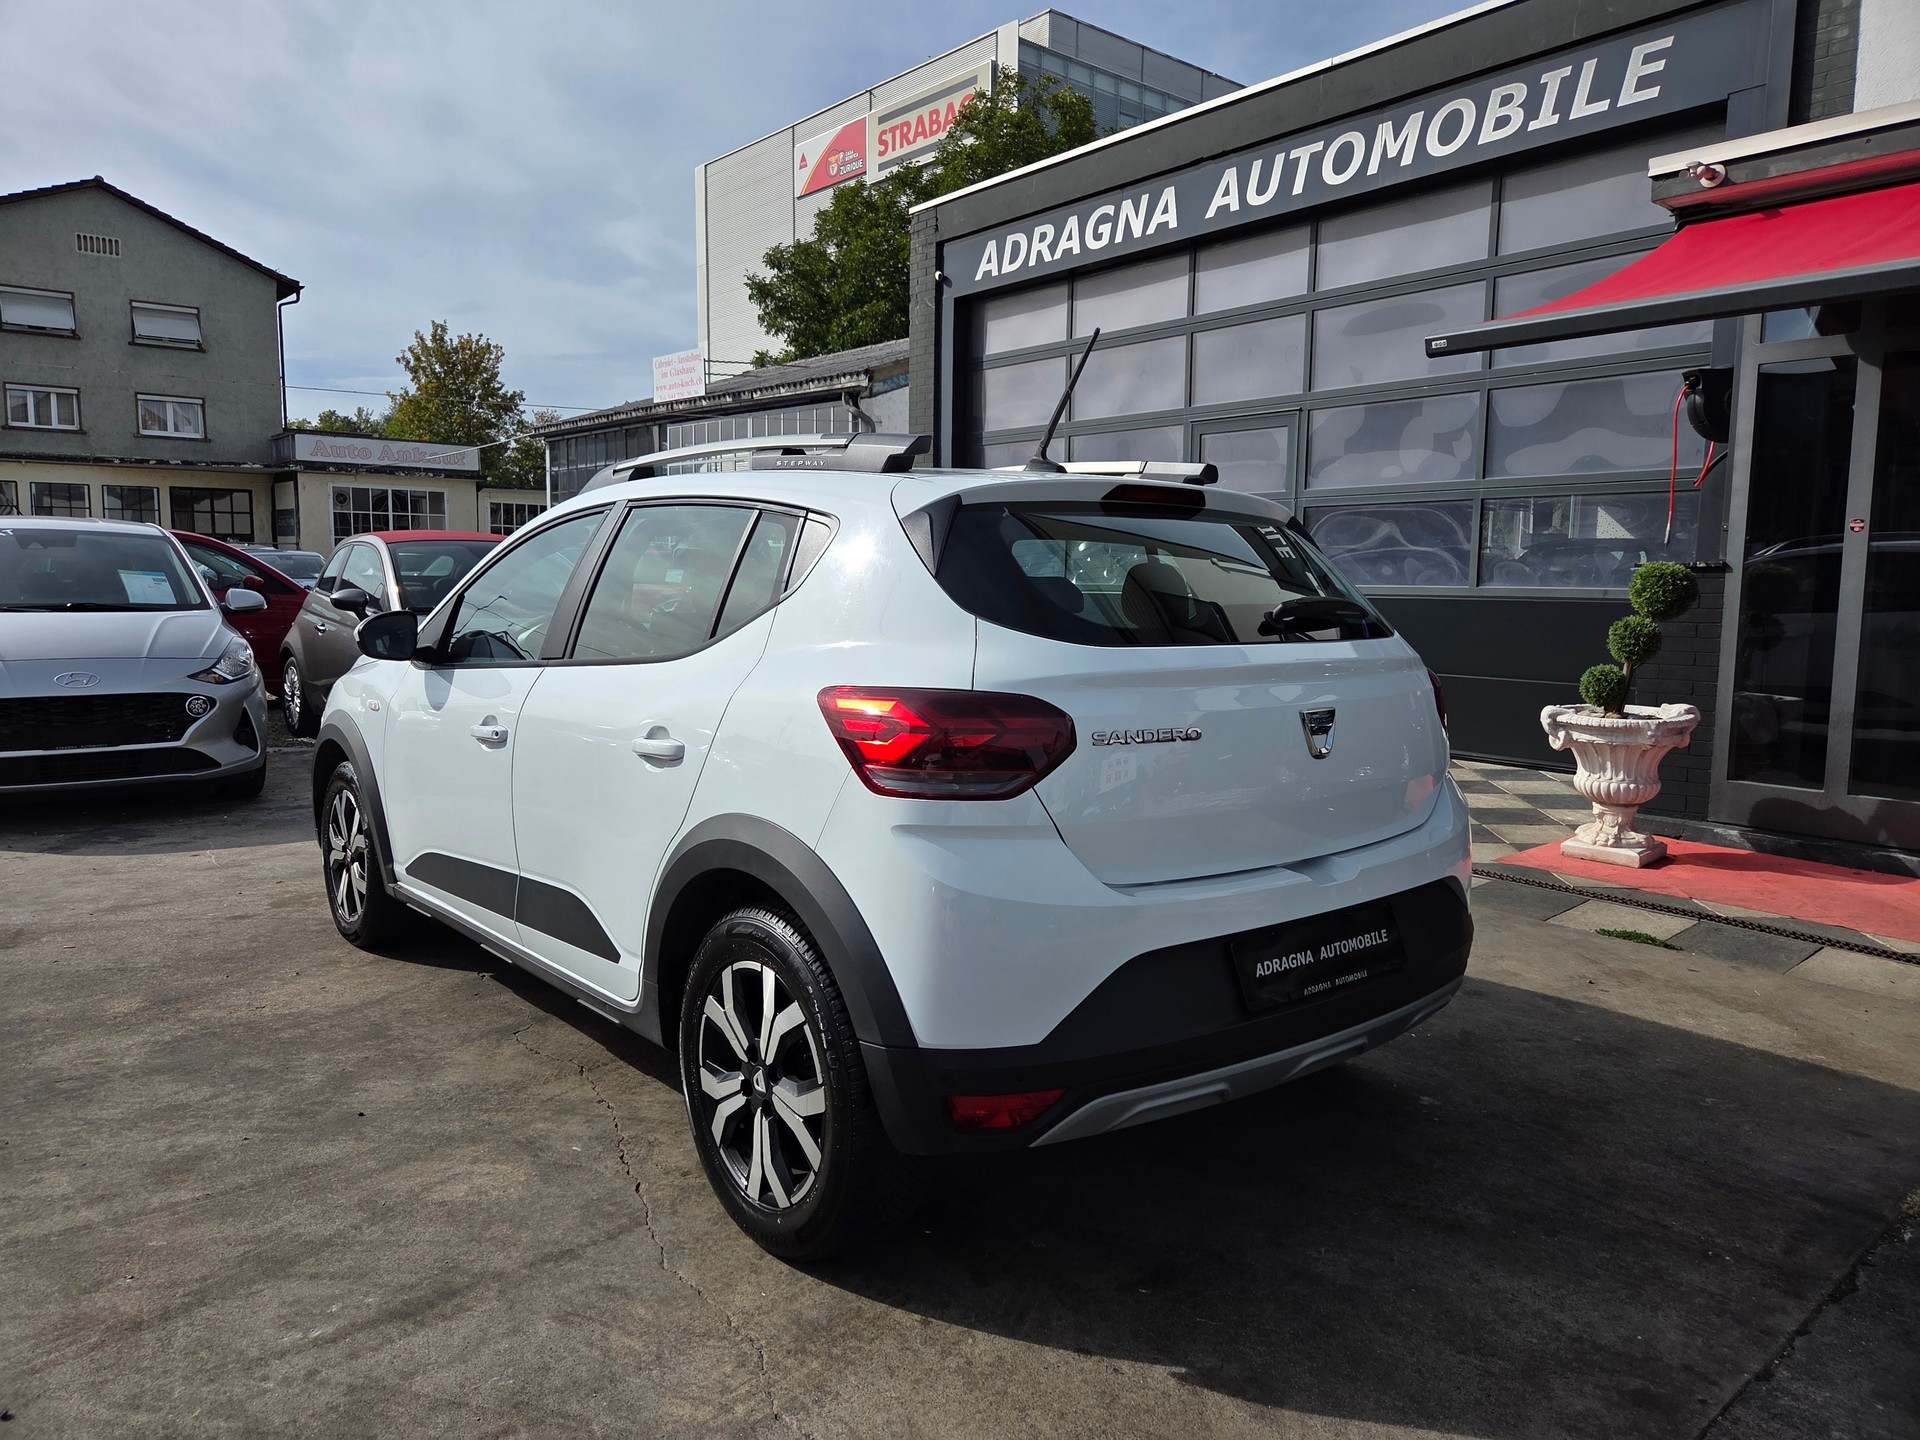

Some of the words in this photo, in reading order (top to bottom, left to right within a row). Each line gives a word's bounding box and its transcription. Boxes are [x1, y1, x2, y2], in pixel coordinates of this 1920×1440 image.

[974, 186, 1178, 281] ADRAGNA
[1204, 35, 1675, 219] AUTOMOBILE
[670, 366, 696, 377] Glashaus
[311, 440, 372, 459] Auto
[378, 444, 466, 465] Ankauf
[1091, 727, 1203, 746] SANDERO
[1255, 949, 1314, 978] ADRAGNA
[1320, 929, 1389, 960] AUTOMOBILE
[1303, 981, 1332, 996] ADRAGNA
[1335, 970, 1368, 986] AUTOMOBILE
